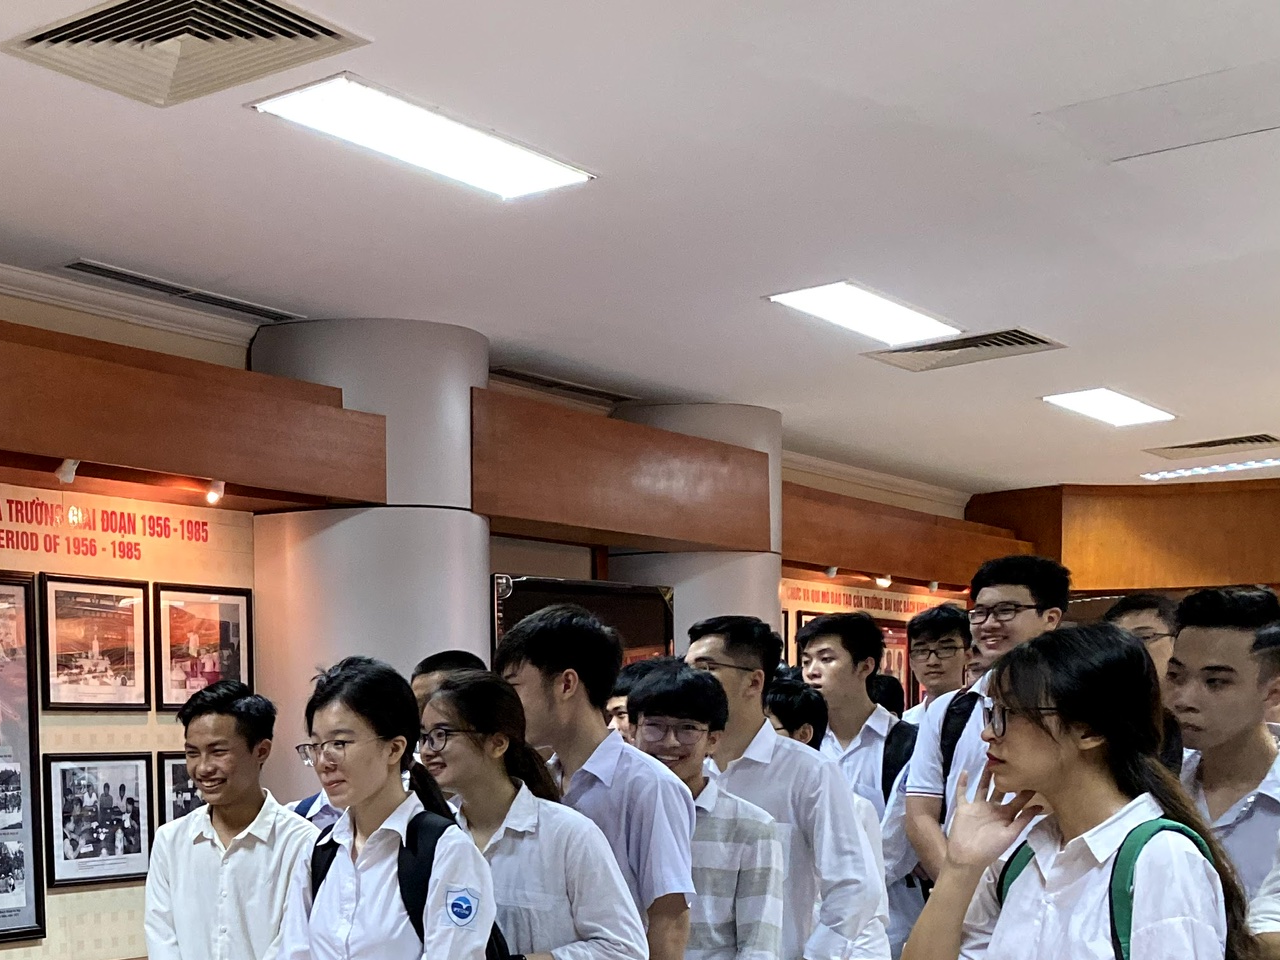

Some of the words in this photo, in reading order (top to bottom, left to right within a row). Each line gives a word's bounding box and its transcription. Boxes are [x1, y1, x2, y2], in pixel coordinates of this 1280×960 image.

[101, 509, 137, 538] ĐOẠN
[43, 534, 60, 554] OF
[65, 537, 97, 557] 1956
[110, 541, 141, 561] 1985
